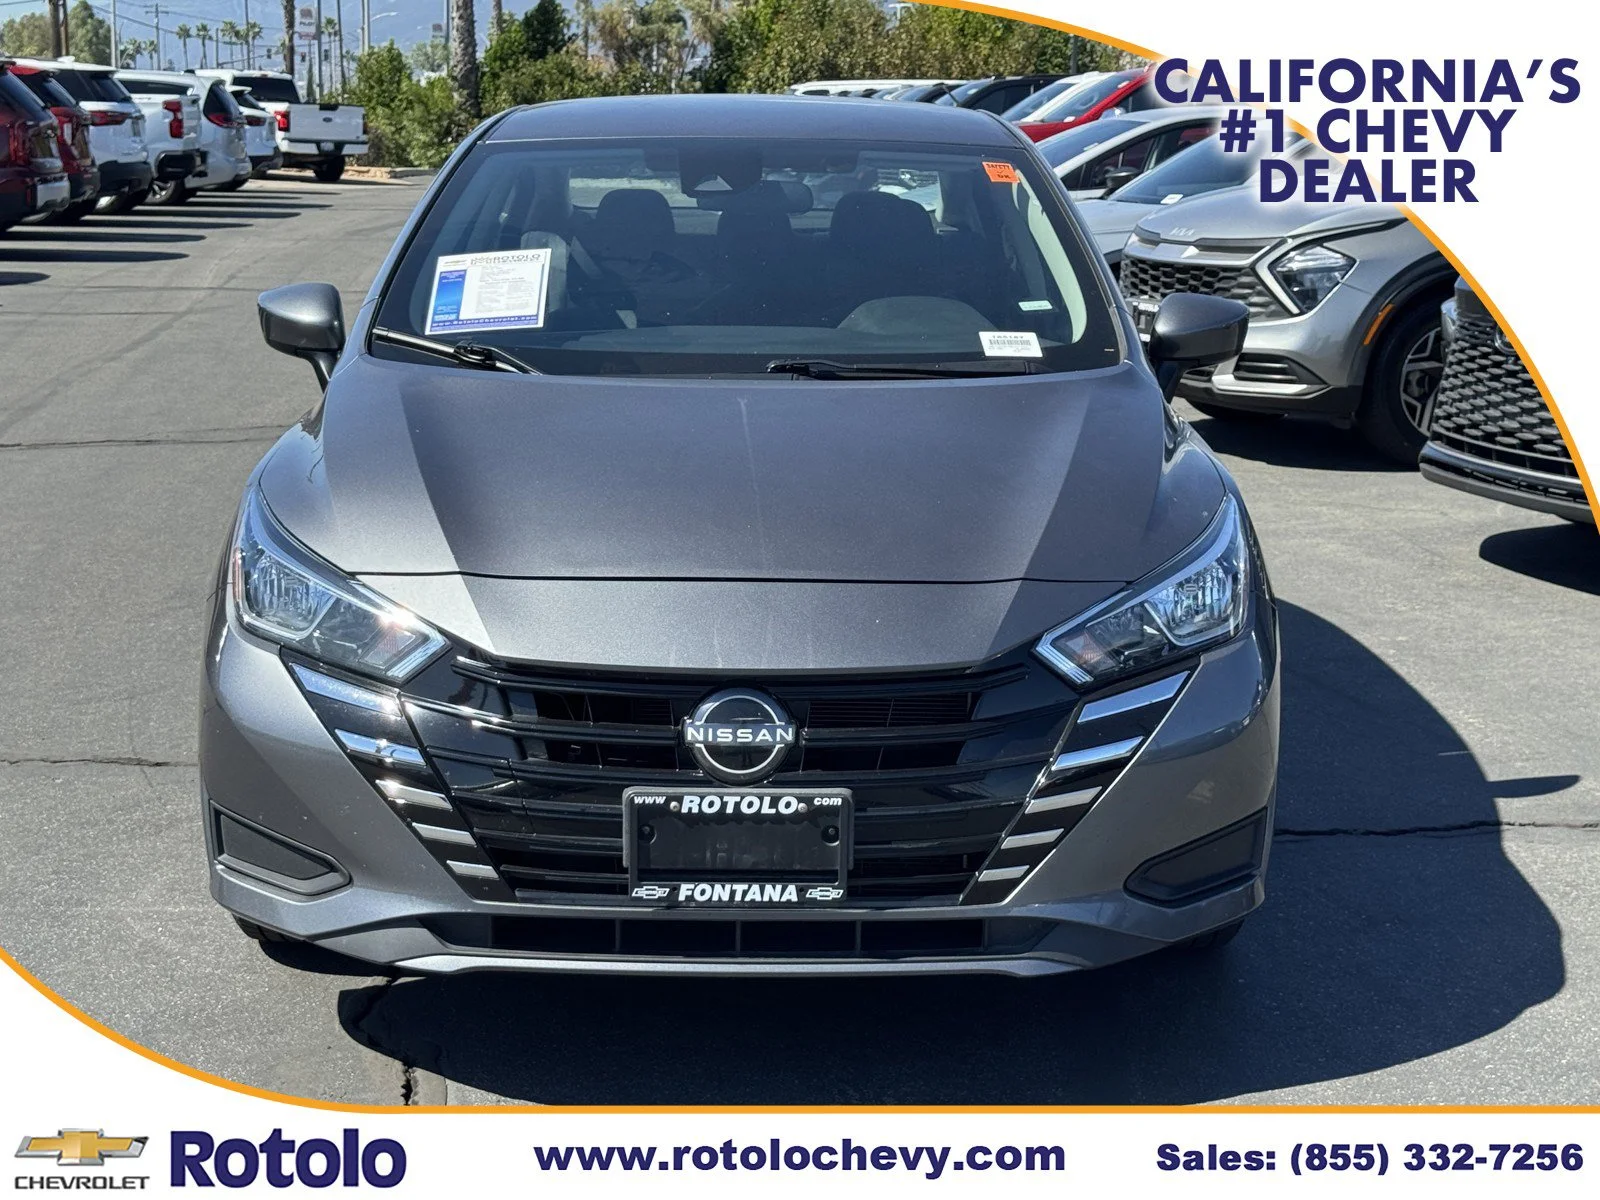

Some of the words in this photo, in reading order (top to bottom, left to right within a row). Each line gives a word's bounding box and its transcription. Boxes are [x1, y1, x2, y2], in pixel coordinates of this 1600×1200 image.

[687, 727, 793, 742] NISSAN
[633, 796, 666, 804] www
[681, 795, 798, 814] ROTOLO
[813, 797, 842, 806] com
[678, 884, 798, 902] FONTANA
